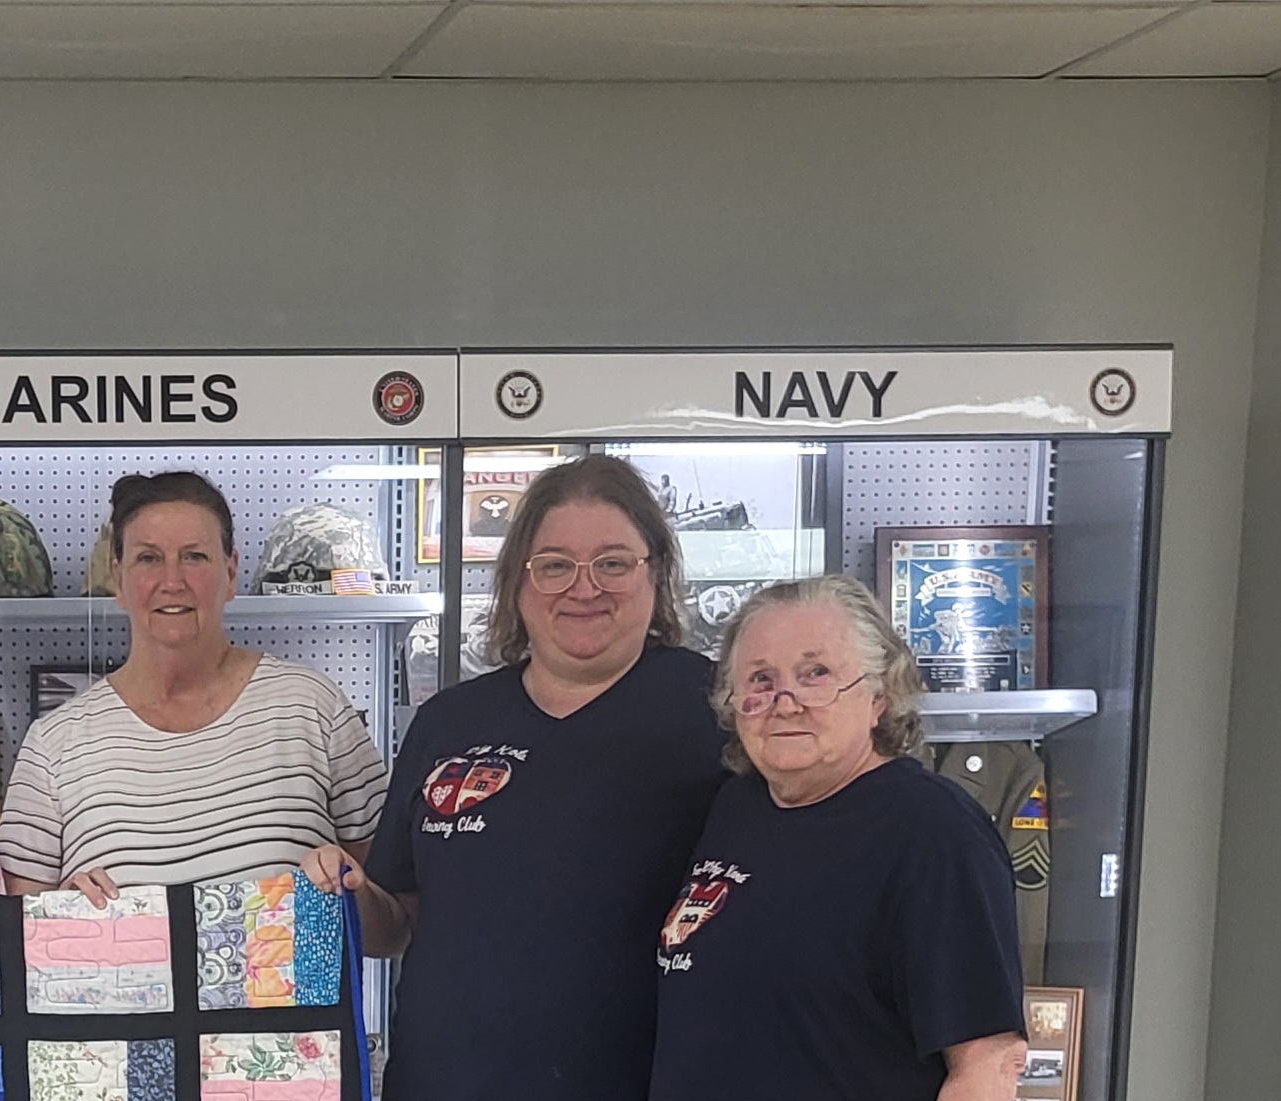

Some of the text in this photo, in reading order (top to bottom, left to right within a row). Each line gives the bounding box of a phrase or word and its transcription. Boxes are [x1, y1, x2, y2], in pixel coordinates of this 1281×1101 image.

[734, 370, 898, 418] NAVY
[385, 583, 413, 595] ARMY
[457, 815, 486, 832] Club
